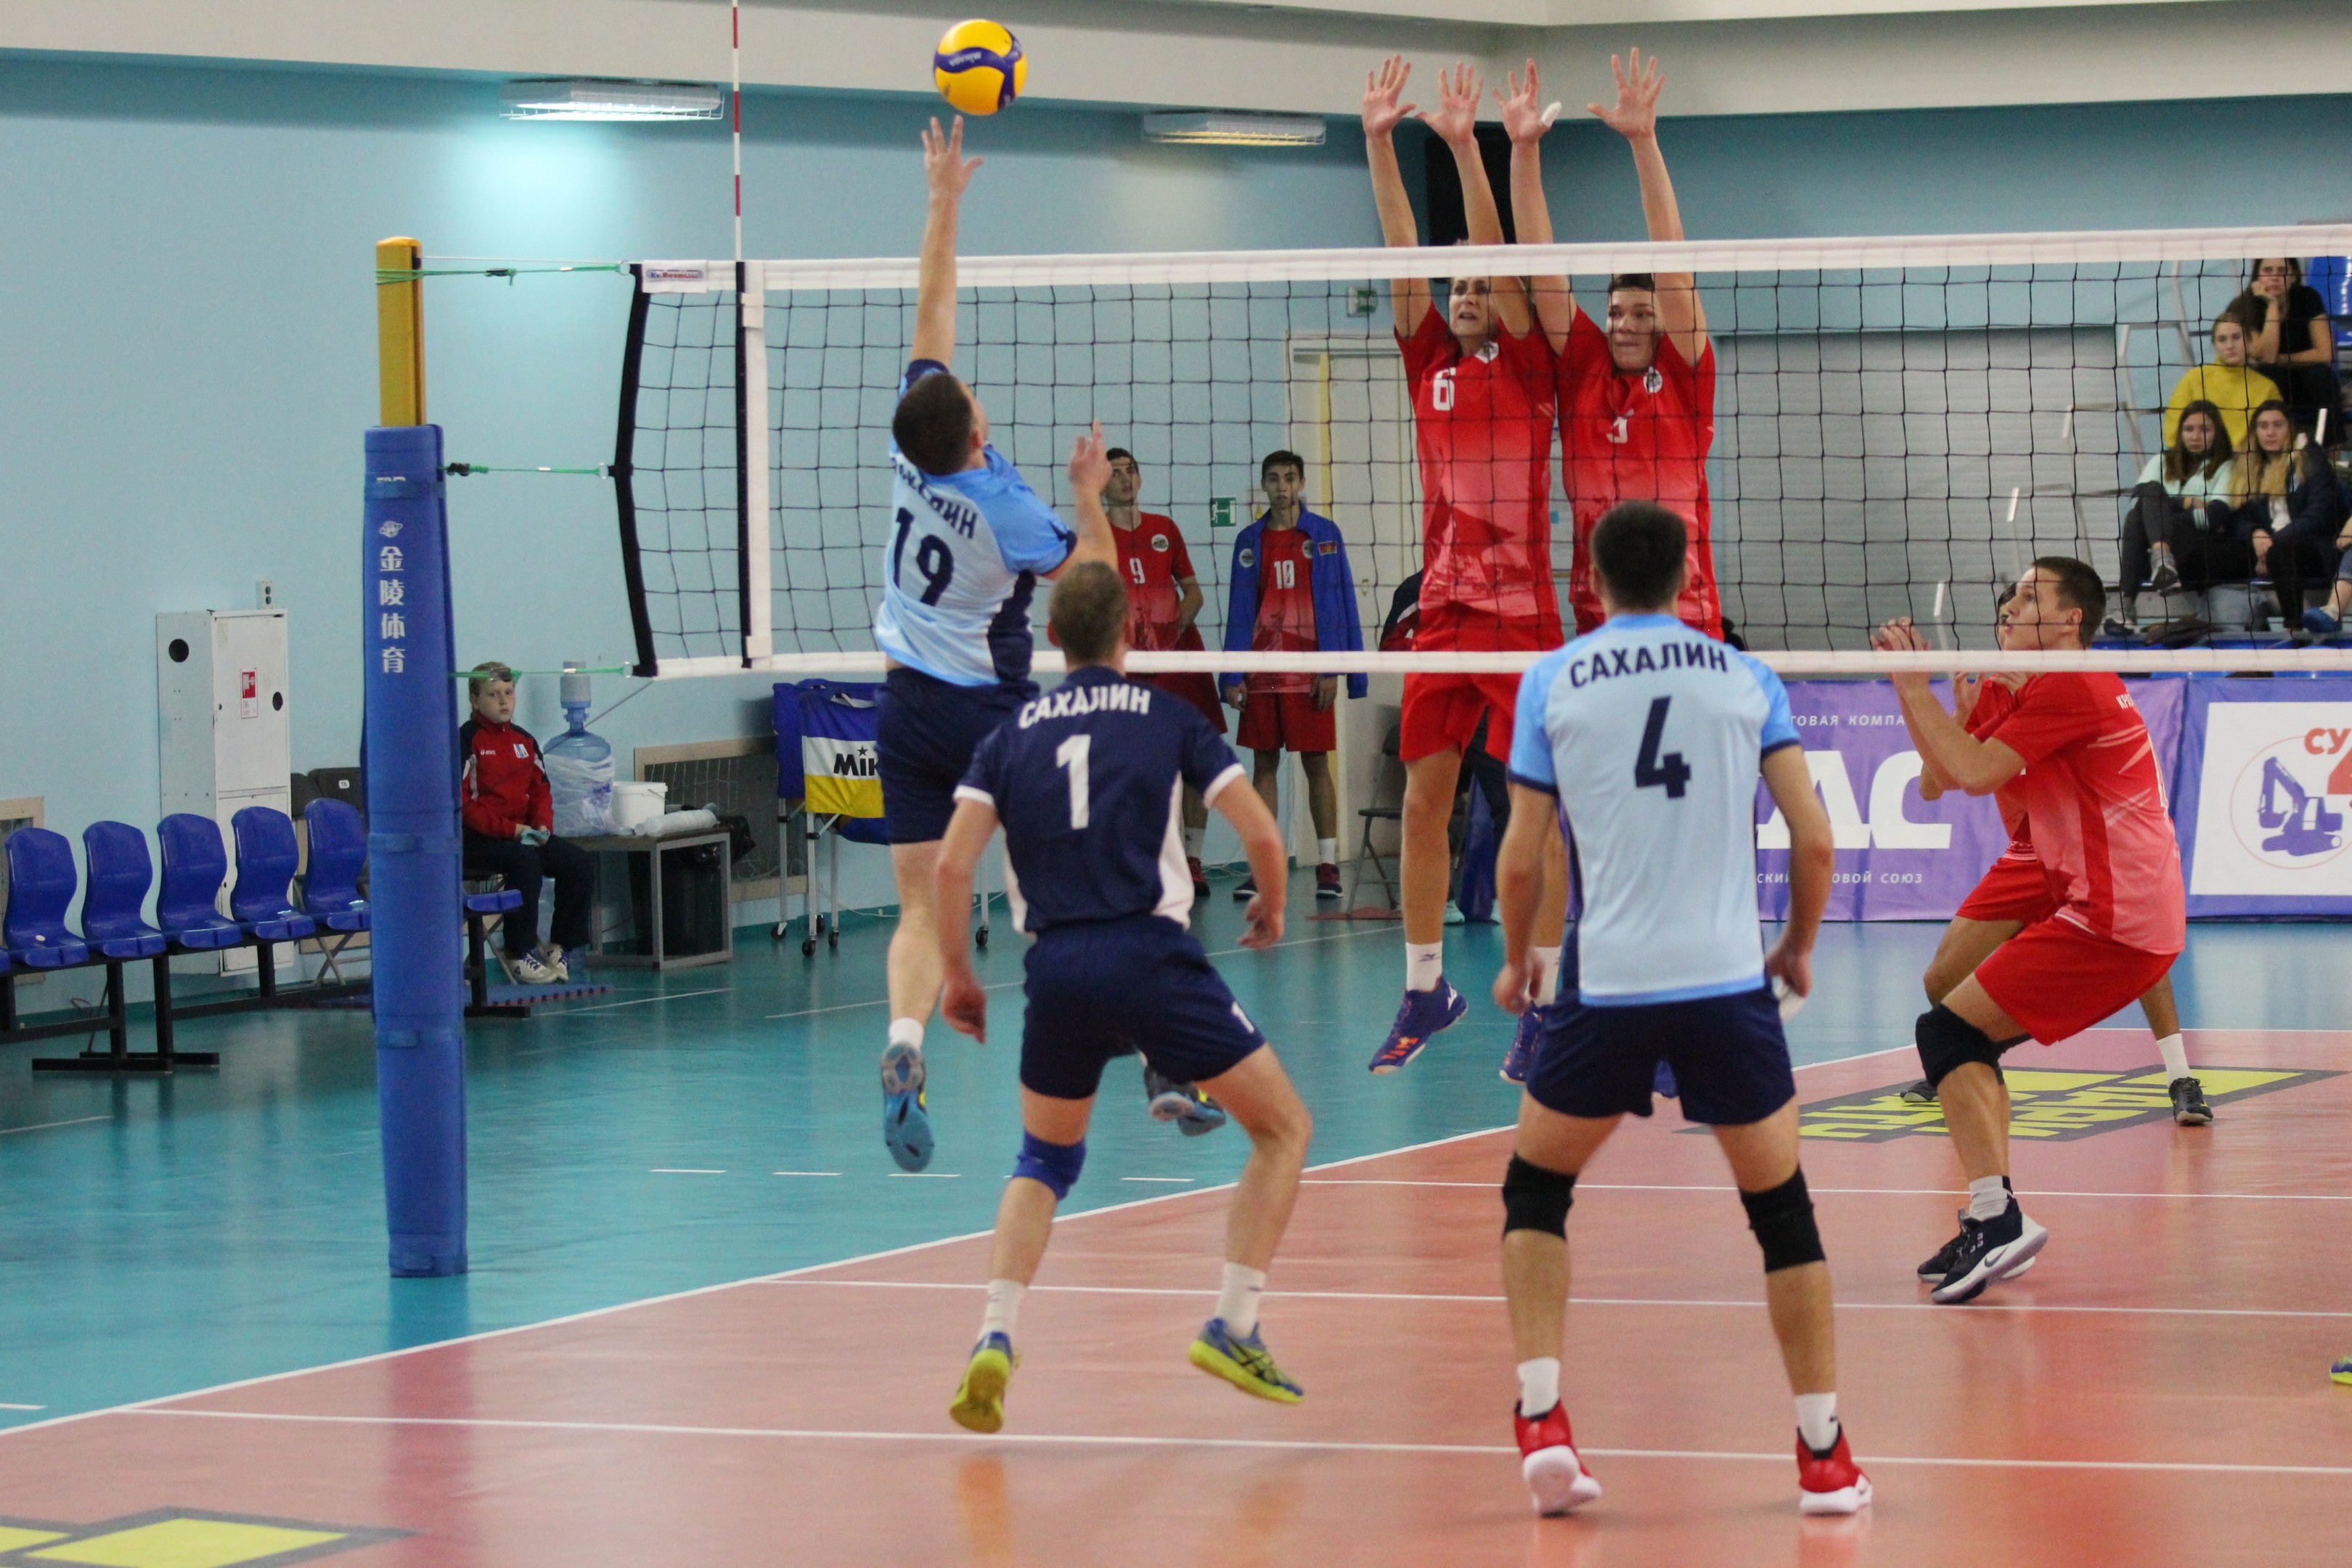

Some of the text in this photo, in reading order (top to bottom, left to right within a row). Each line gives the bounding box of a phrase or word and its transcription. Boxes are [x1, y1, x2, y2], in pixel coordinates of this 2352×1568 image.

[1432, 367, 1456, 412] 6
[894, 507, 954, 607] 19
[1129, 557, 1146, 584] 9
[1274, 560, 1295, 589] 10
[379, 546, 406, 674] 金陵体育
[1570, 642, 1728, 688] САХАЛИН
[1018, 684, 1151, 729] САХАЛИН
[1635, 695, 1691, 799] 4
[1056, 734, 1092, 830] 1
[1757, 750, 1953, 849] АС
[1757, 871, 1922, 884] СКИ ОВОЙ СОЮЗ
